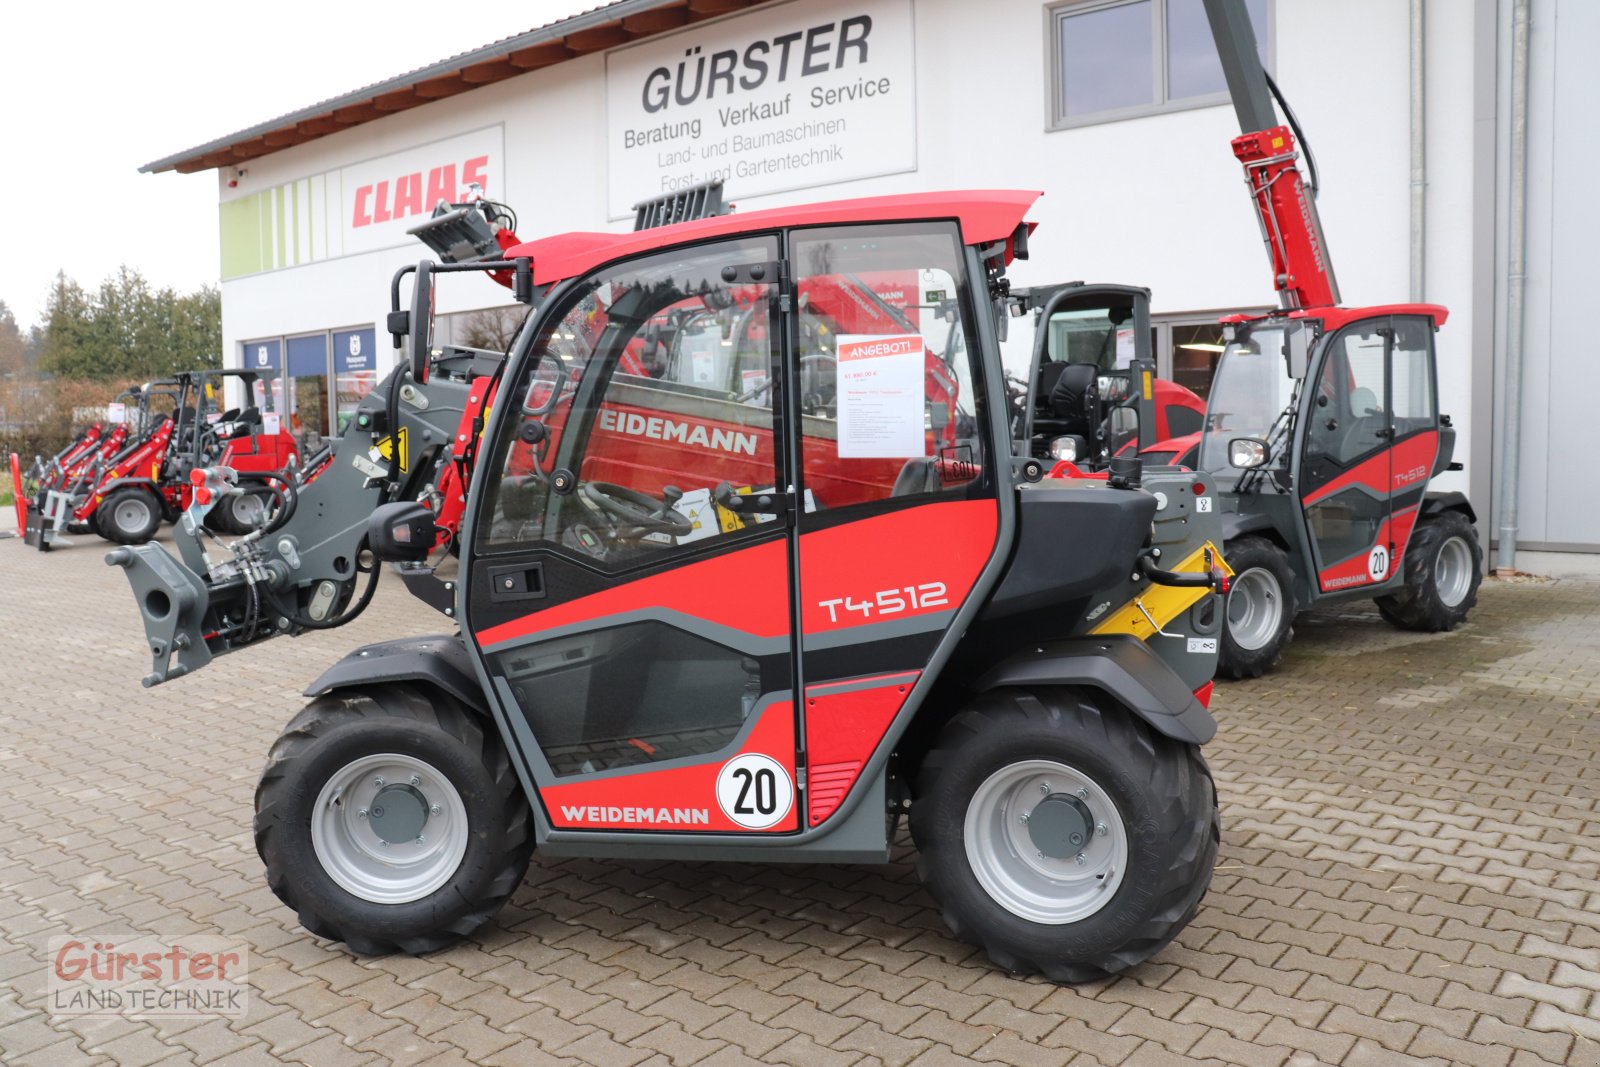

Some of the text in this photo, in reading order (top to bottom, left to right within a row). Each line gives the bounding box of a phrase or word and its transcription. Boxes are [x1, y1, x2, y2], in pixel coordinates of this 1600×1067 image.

[641, 14, 873, 114] GÜRSTER
[624, 76, 891, 149] Beratung Verkauf Service
[658, 117, 846, 168] Land- und Baumaschinen
[352, 154, 489, 228] CLAAS
[661, 171, 700, 192] Forst-
[736, 143, 844, 179] Gartentechnik
[1293, 177, 1325, 273] WEIDEMANN
[849, 341, 911, 358] ANGEBOT!
[599, 409, 758, 456] EIDEMANN
[1373, 551, 1385, 574] 20
[818, 581, 949, 623] T4512
[560, 805, 709, 825] WEIDEMANN
[732, 767, 777, 815] 20
